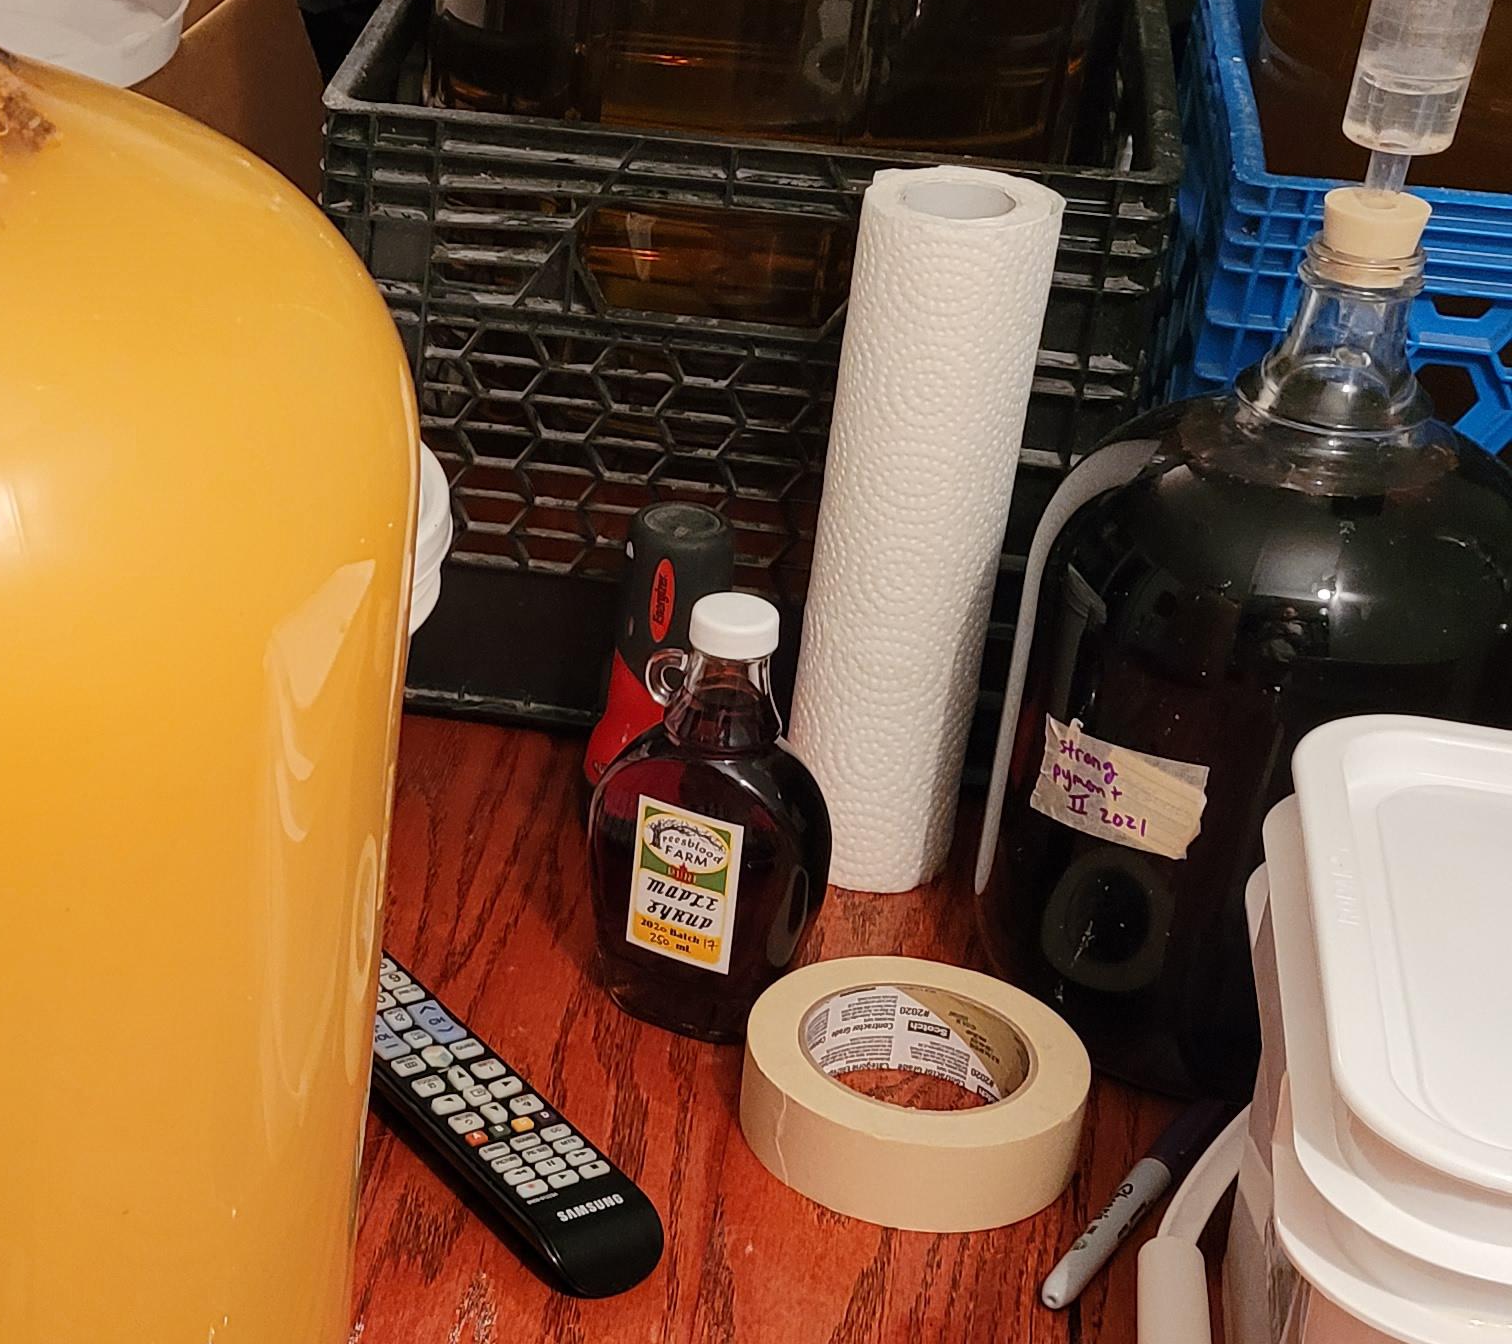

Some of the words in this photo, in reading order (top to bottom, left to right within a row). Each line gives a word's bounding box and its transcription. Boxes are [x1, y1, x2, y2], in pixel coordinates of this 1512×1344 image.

[1059, 740, 1118, 784] strong
[1067, 794, 1090, 816] II
[1100, 808, 1147, 837] 2021
[664, 846, 709, 868] FARM
[640, 917, 668, 935] 2020
[669, 927, 701, 945] Batch
[649, 932, 670, 946] 250
[899, 1007, 930, 1018] #2020
[831, 1026, 852, 1038] Grade
[852, 1022, 894, 1032] Contractor
[909, 1021, 949, 1037] Scotch
[556, 1193, 625, 1223] SAMSUNG
